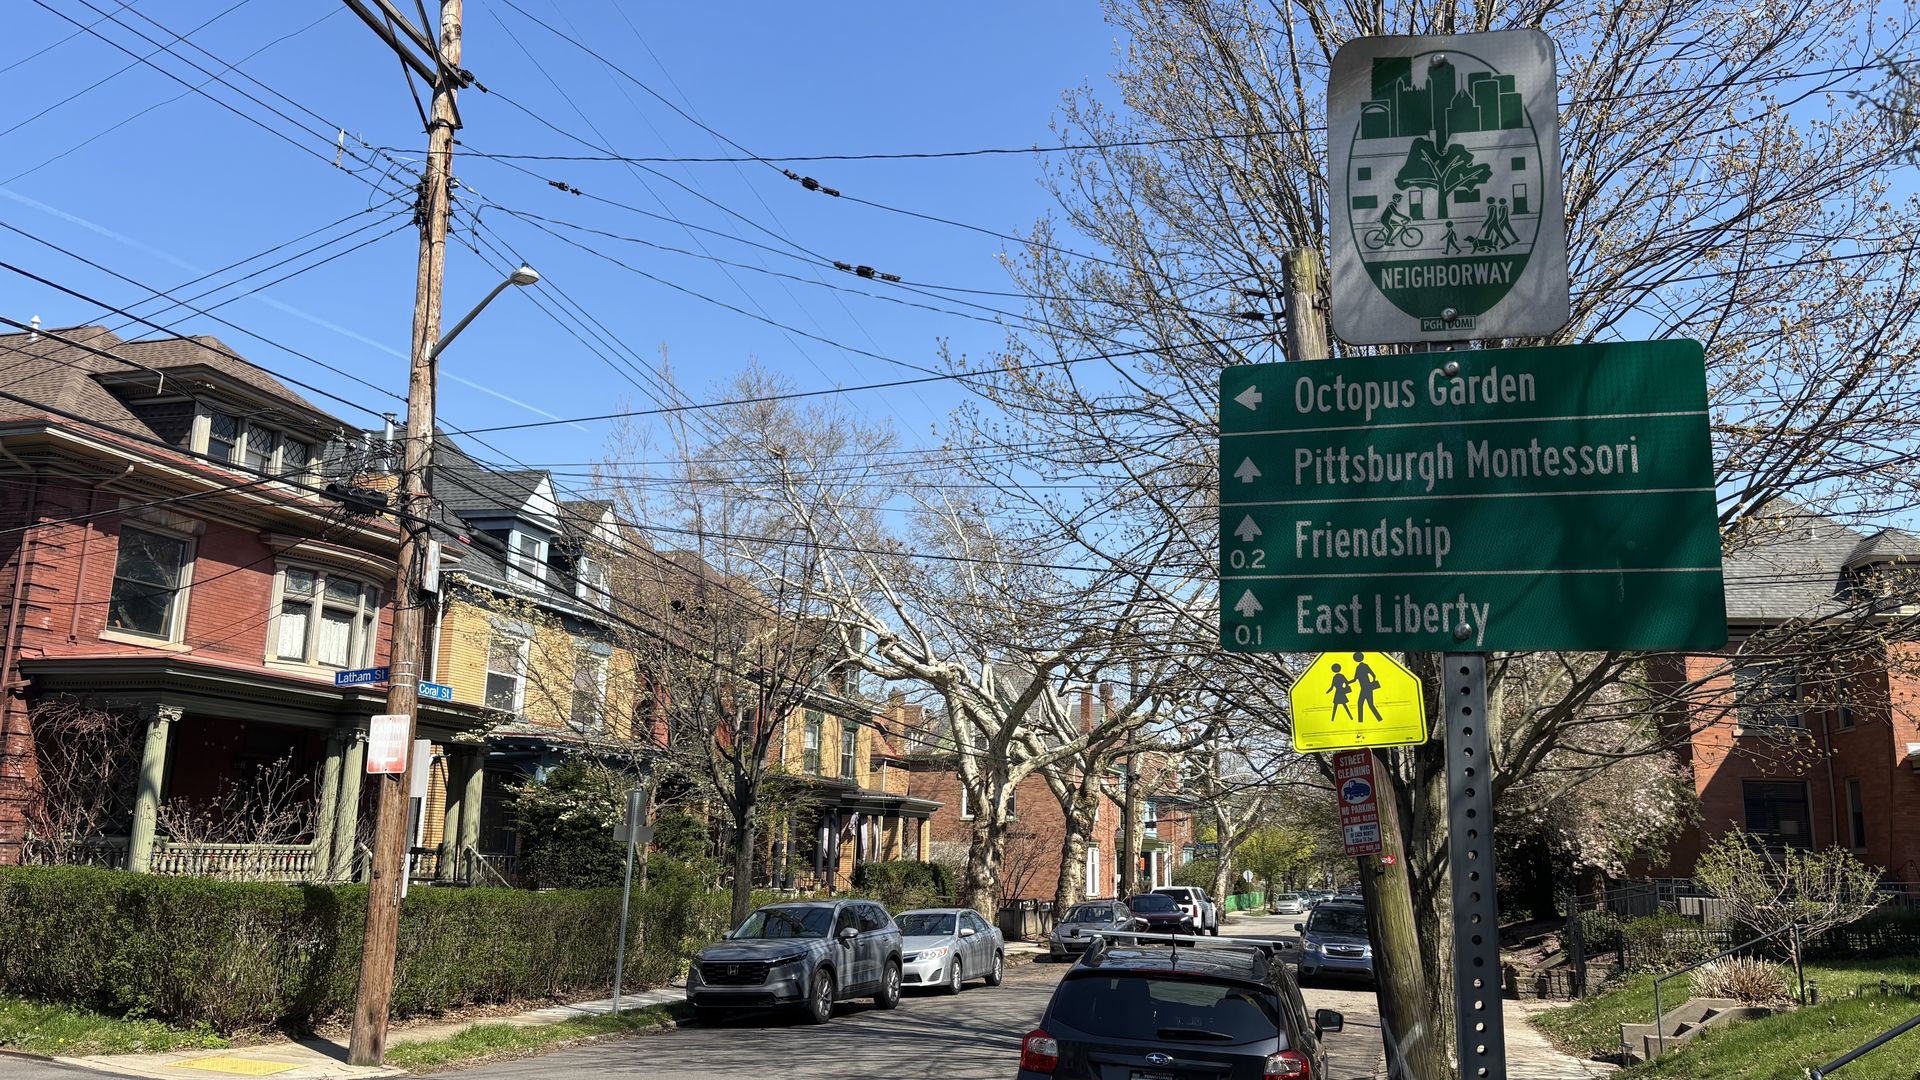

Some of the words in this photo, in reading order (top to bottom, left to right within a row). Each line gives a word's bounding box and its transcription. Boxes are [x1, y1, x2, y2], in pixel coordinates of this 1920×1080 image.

[1381, 261, 1513, 290] NEIGHBORWAY
[1423, 320, 1443, 330] PGH
[1447, 318, 1473, 329] DOMI
[1295, 375, 1415, 422] Octopus
[1428, 366, 1536, 407] Garden
[1295, 441, 1453, 492] Pittsburgh
[1467, 436, 1639, 478] Montessori
[1295, 517, 1451, 568] Friendship
[1230, 549, 1266, 569] 0.2
[1297, 594, 1363, 634] East
[1375, 593, 1489, 647] Liberty
[1235, 625, 1262, 645] 0.1
[337, 671, 371, 683] Latham
[374, 670, 385, 680] St
[419, 683, 439, 696] Coral
[441, 688, 450, 699] St
[1339, 753, 1365, 767] STREET
[1337, 765, 1370, 779] CLEANING
[1341, 806, 1350, 816] NO
[1351, 802, 1376, 814] PARKING
